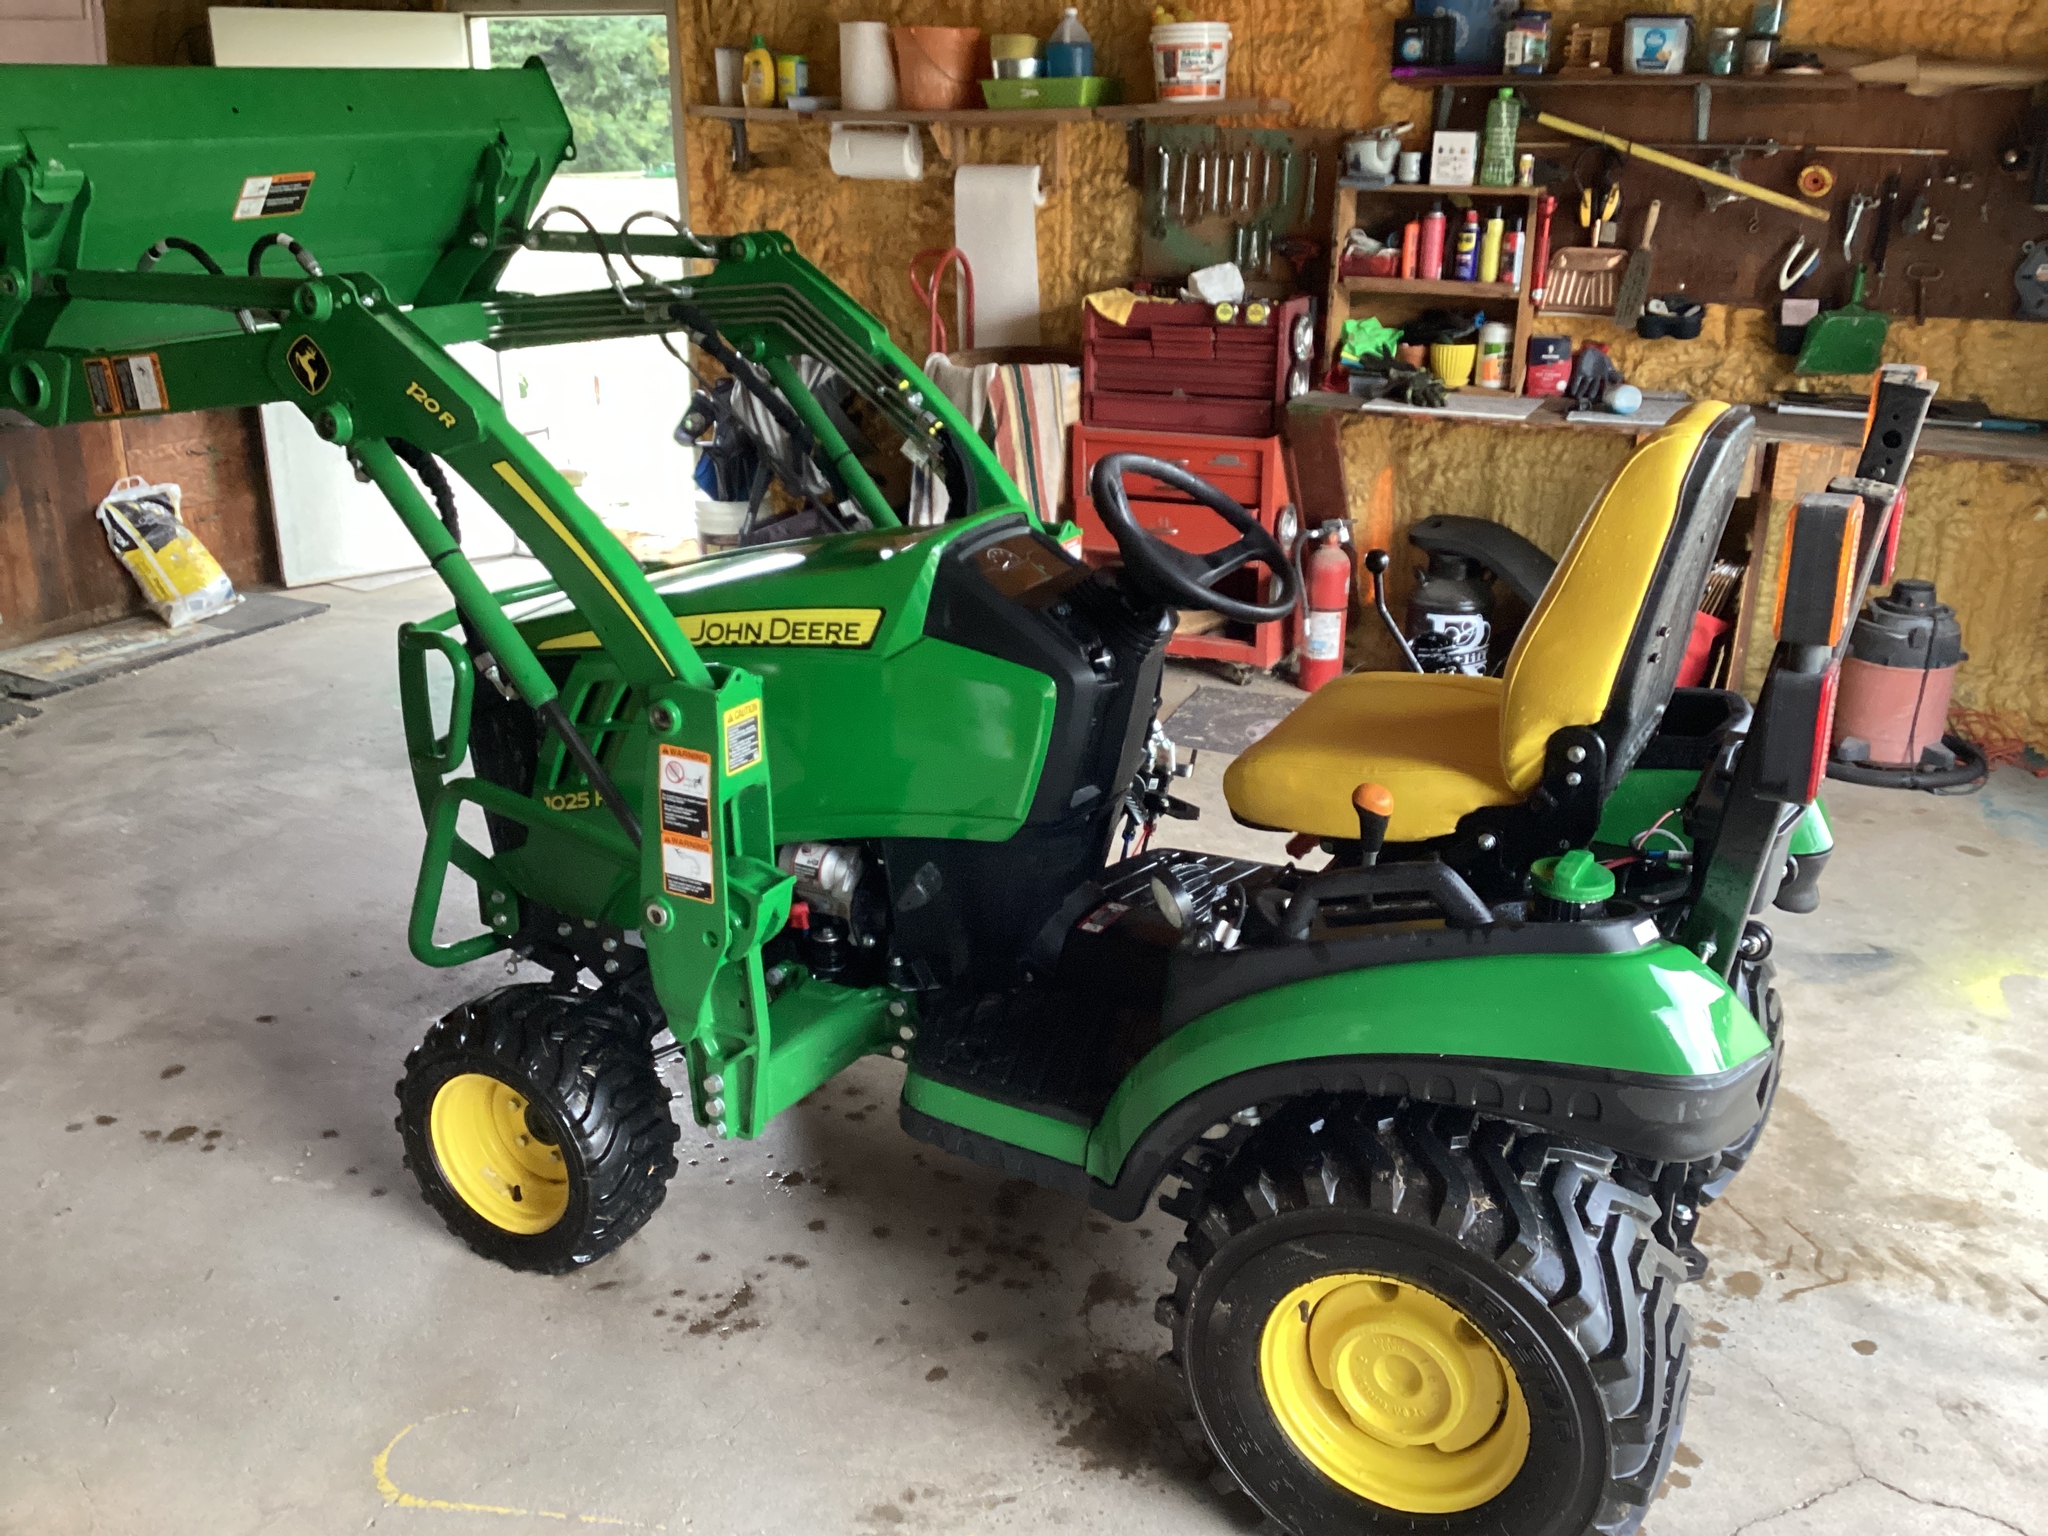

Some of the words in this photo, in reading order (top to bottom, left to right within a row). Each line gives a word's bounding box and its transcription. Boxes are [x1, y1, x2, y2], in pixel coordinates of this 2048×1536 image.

[691, 619, 762, 642] JOHN
[769, 618, 861, 641] DEERE
[669, 748, 708, 762] WARNING
[671, 837, 709, 851] WARNING
